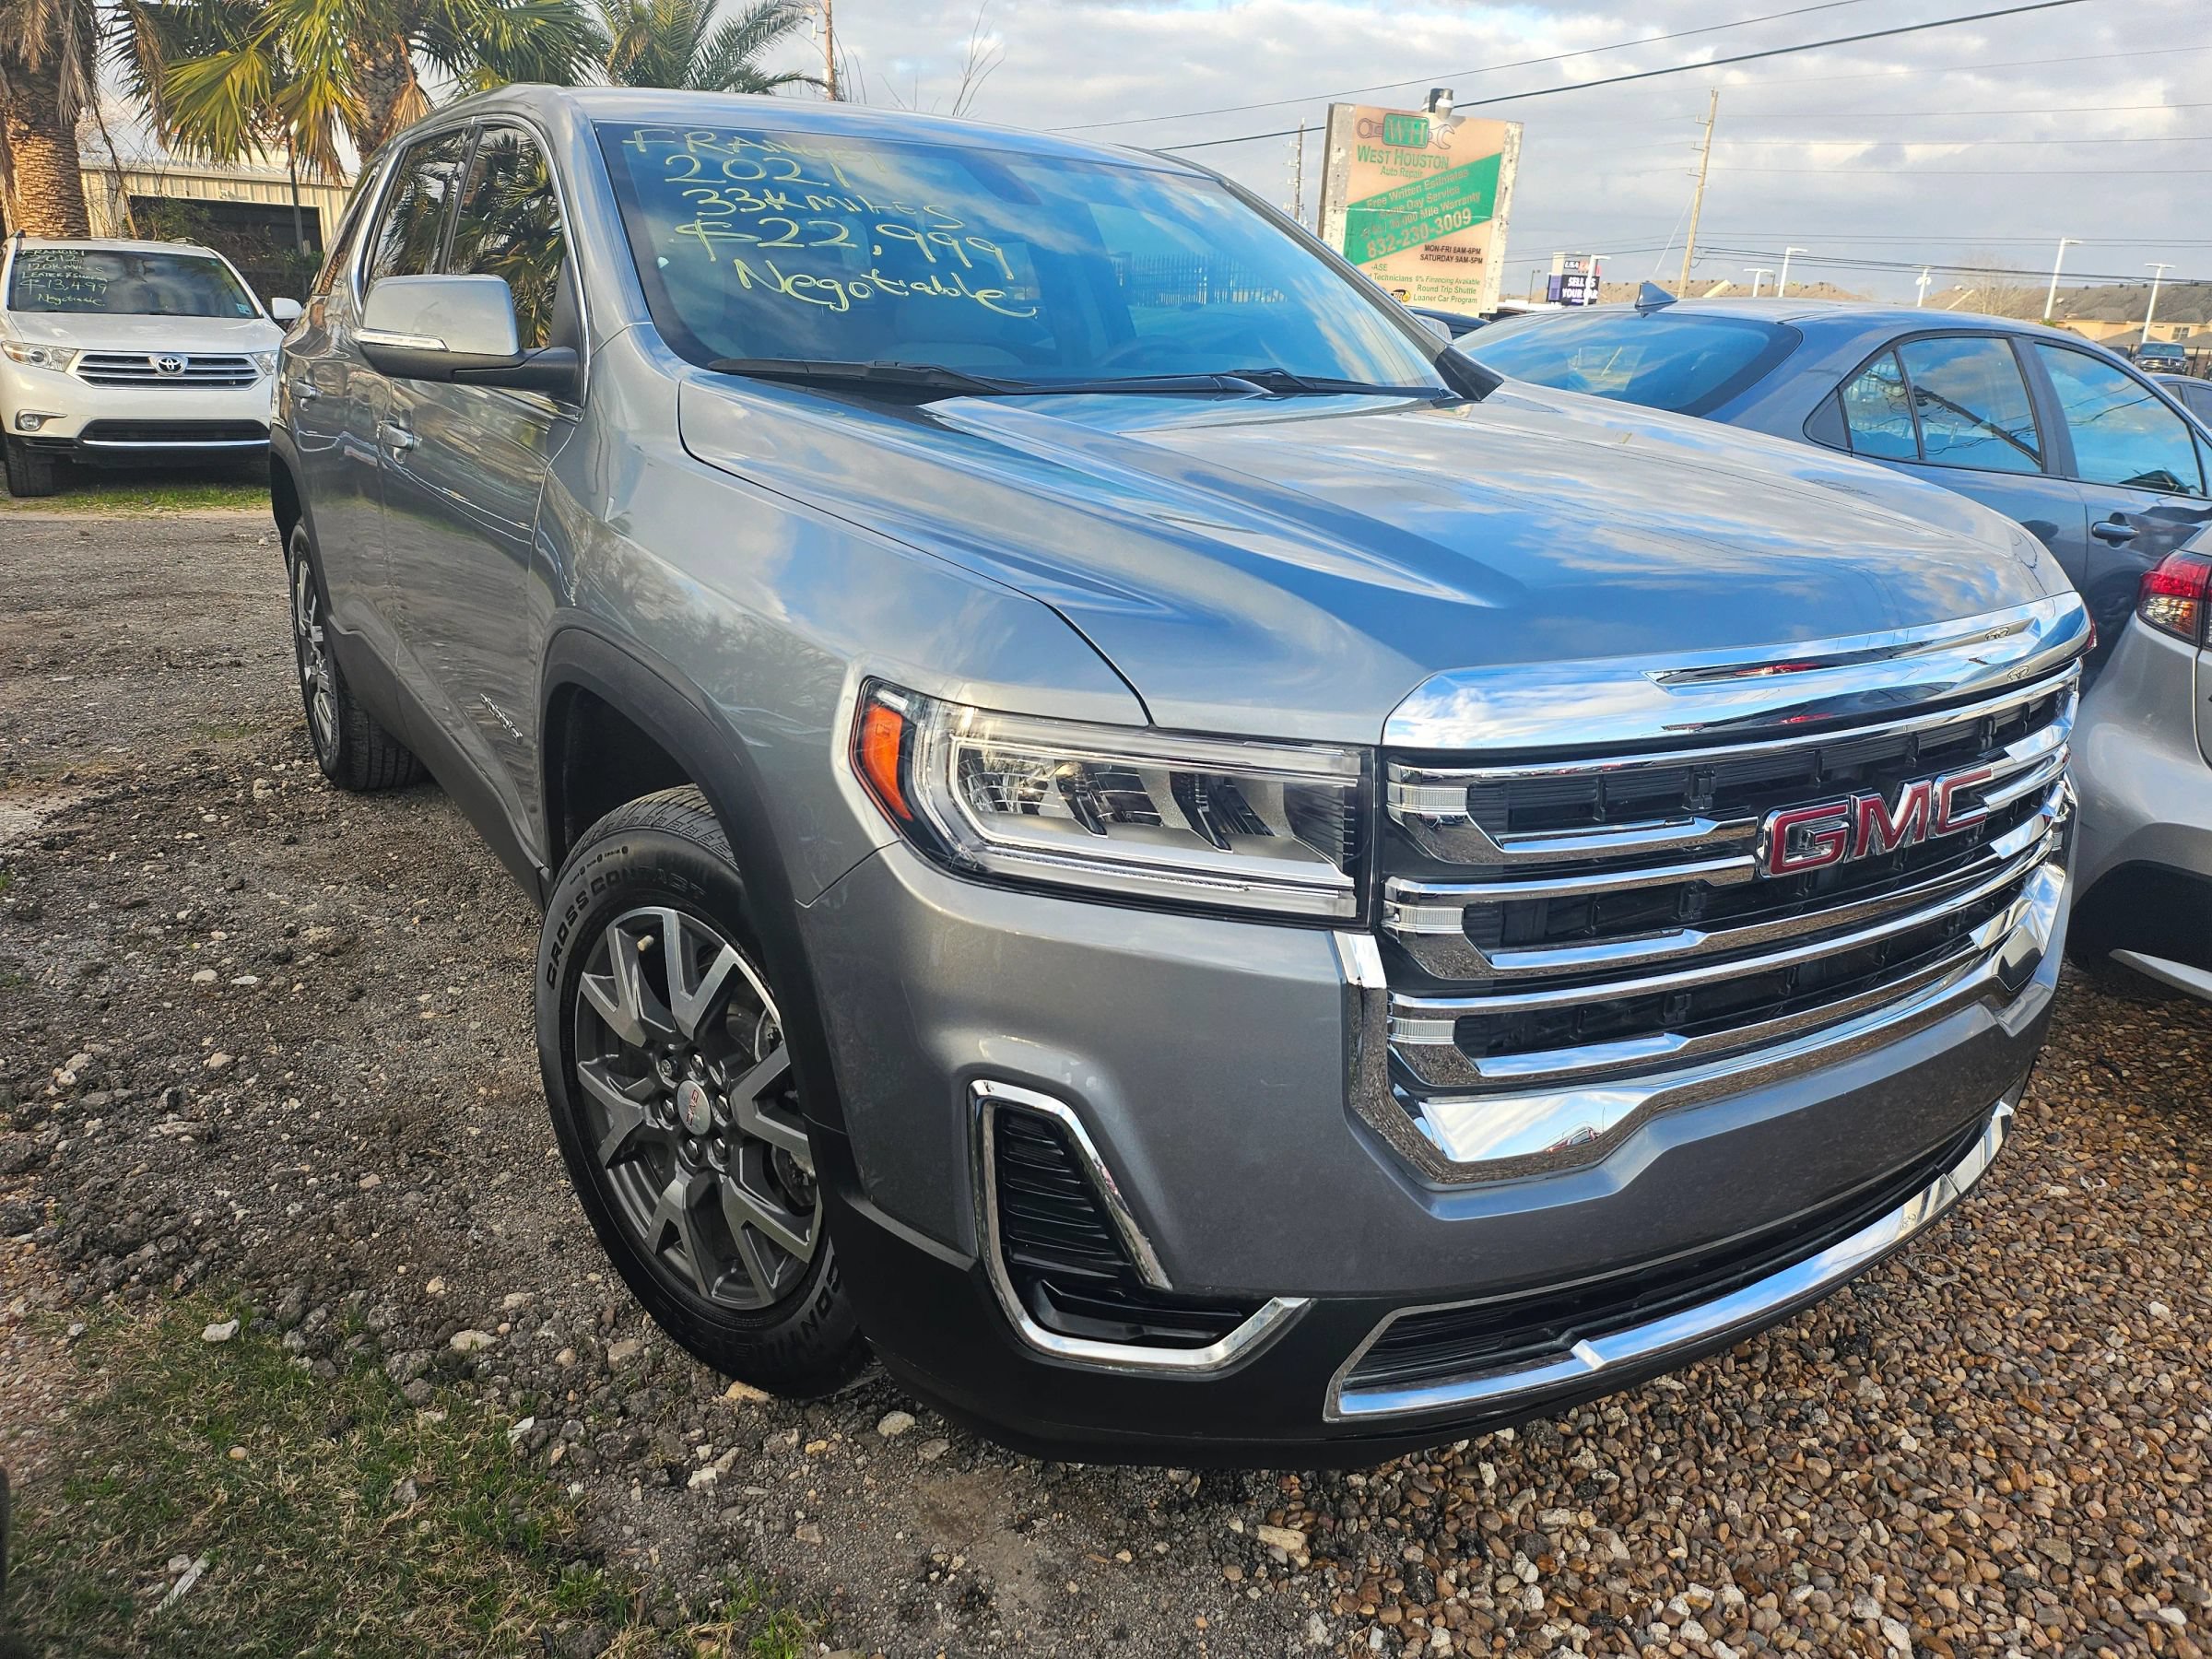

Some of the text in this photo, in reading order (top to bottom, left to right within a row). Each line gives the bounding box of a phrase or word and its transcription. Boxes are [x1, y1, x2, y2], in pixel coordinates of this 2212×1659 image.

[1357, 145, 1450, 170] WEST HOUSTON
[664, 154, 851, 189] 2021
[1380, 166, 1423, 179] Auto Repair
[1366, 170, 1469, 209] Free Written Estimates
[1406, 199, 1424, 212] Day
[1427, 185, 1460, 203] Service
[1420, 206, 1439, 219] Mile
[1441, 192, 1481, 212] Warranty
[1367, 207, 1472, 259] 832-230-3009
[1424, 244, 1452, 253] MON-FRI
[29, 254, 78, 263] 2012
[1420, 253, 1453, 264] SATURDAY
[1373, 274, 1413, 283] Technicians
[1425, 276, 1454, 286] Financing
[1568, 276, 1584, 288] SELL
[1417, 284, 1477, 295] Round Trip Shuttle
[1562, 288, 1583, 299] YOUR
[1413, 294, 1436, 302] Loaner
[1451, 296, 1477, 305] Program
[1757, 767, 1994, 878] GMC
[676, 1089, 700, 1127] GMC
